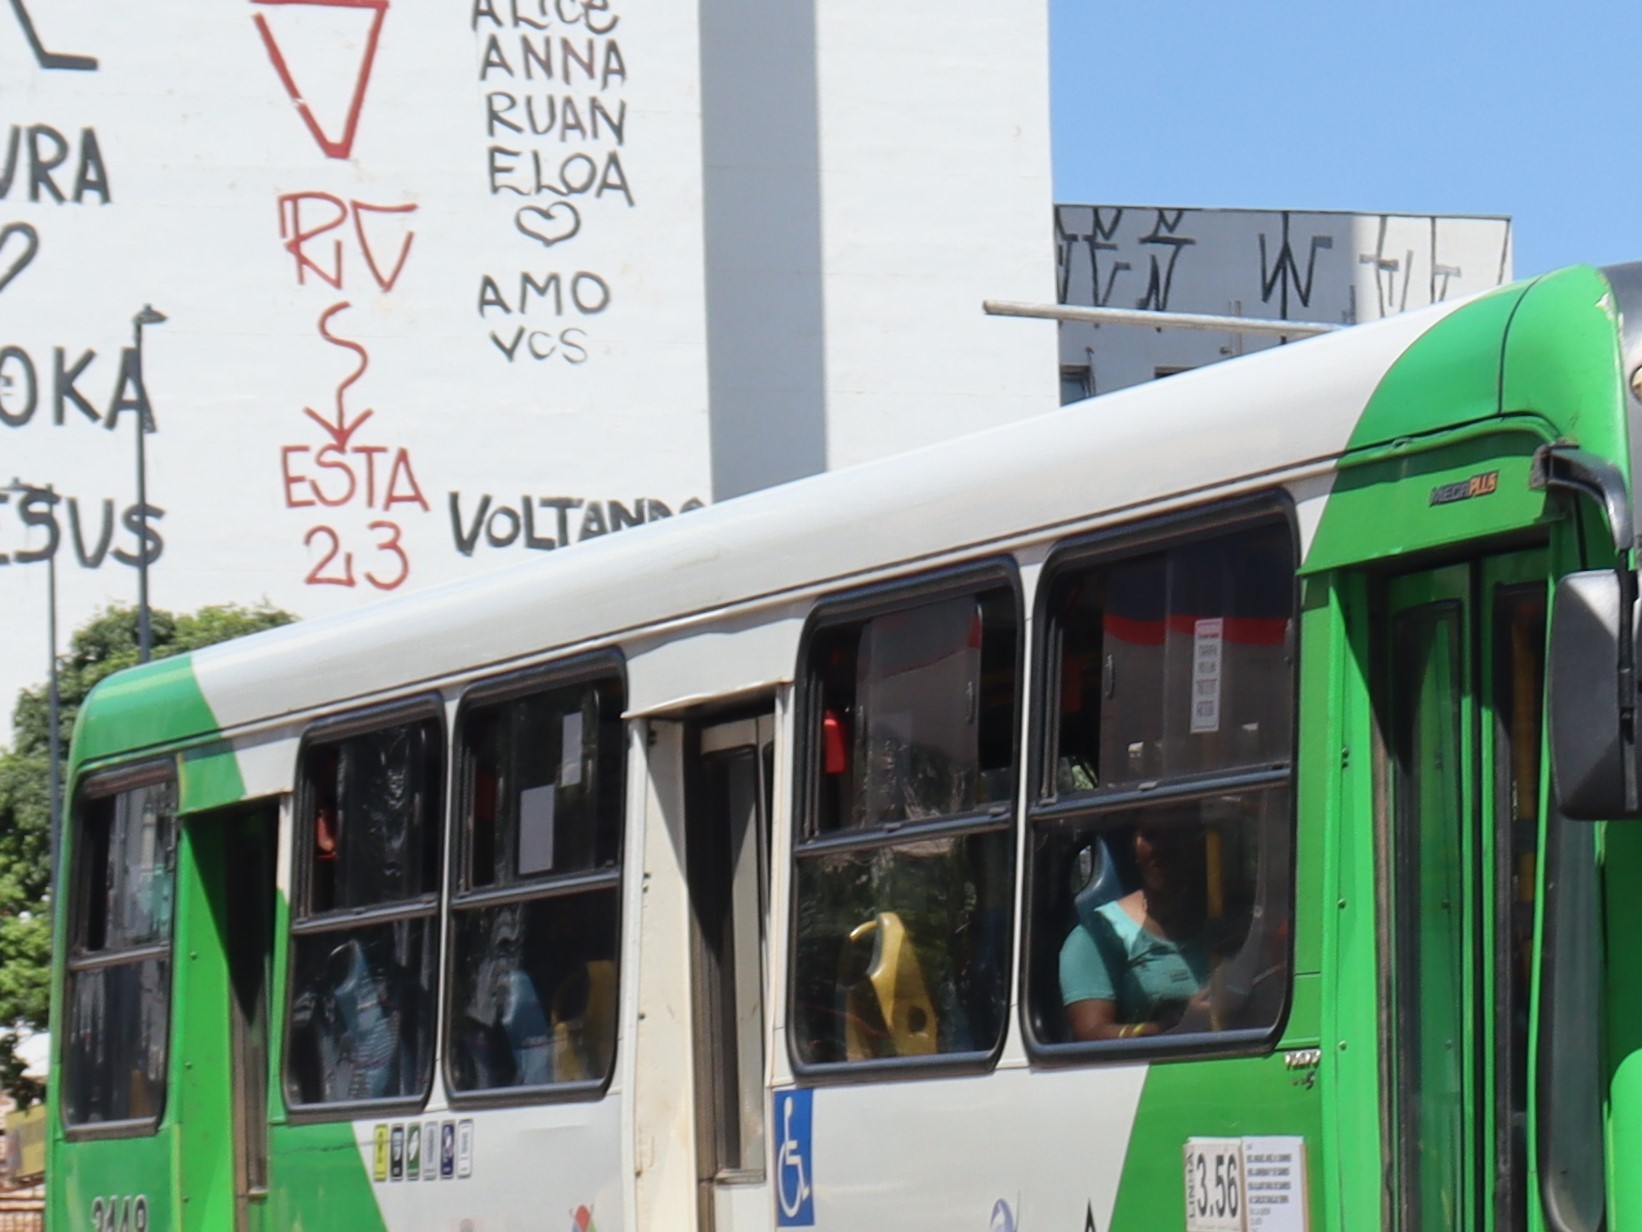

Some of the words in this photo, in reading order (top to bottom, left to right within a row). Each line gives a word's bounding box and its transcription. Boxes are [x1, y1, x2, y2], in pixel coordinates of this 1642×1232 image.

[480, 33, 627, 90] ANNA
[486, 91, 626, 146] RUAN
[487, 145, 634, 207] ELOA
[478, 270, 611, 318] AMO
[490, 325, 589, 364] VCS
[281, 443, 430, 512] ESTA
[0, 494, 166, 569] SUS
[448, 491, 707, 558] VOLTAN
[1196, 1153, 1239, 1219] 3.56
